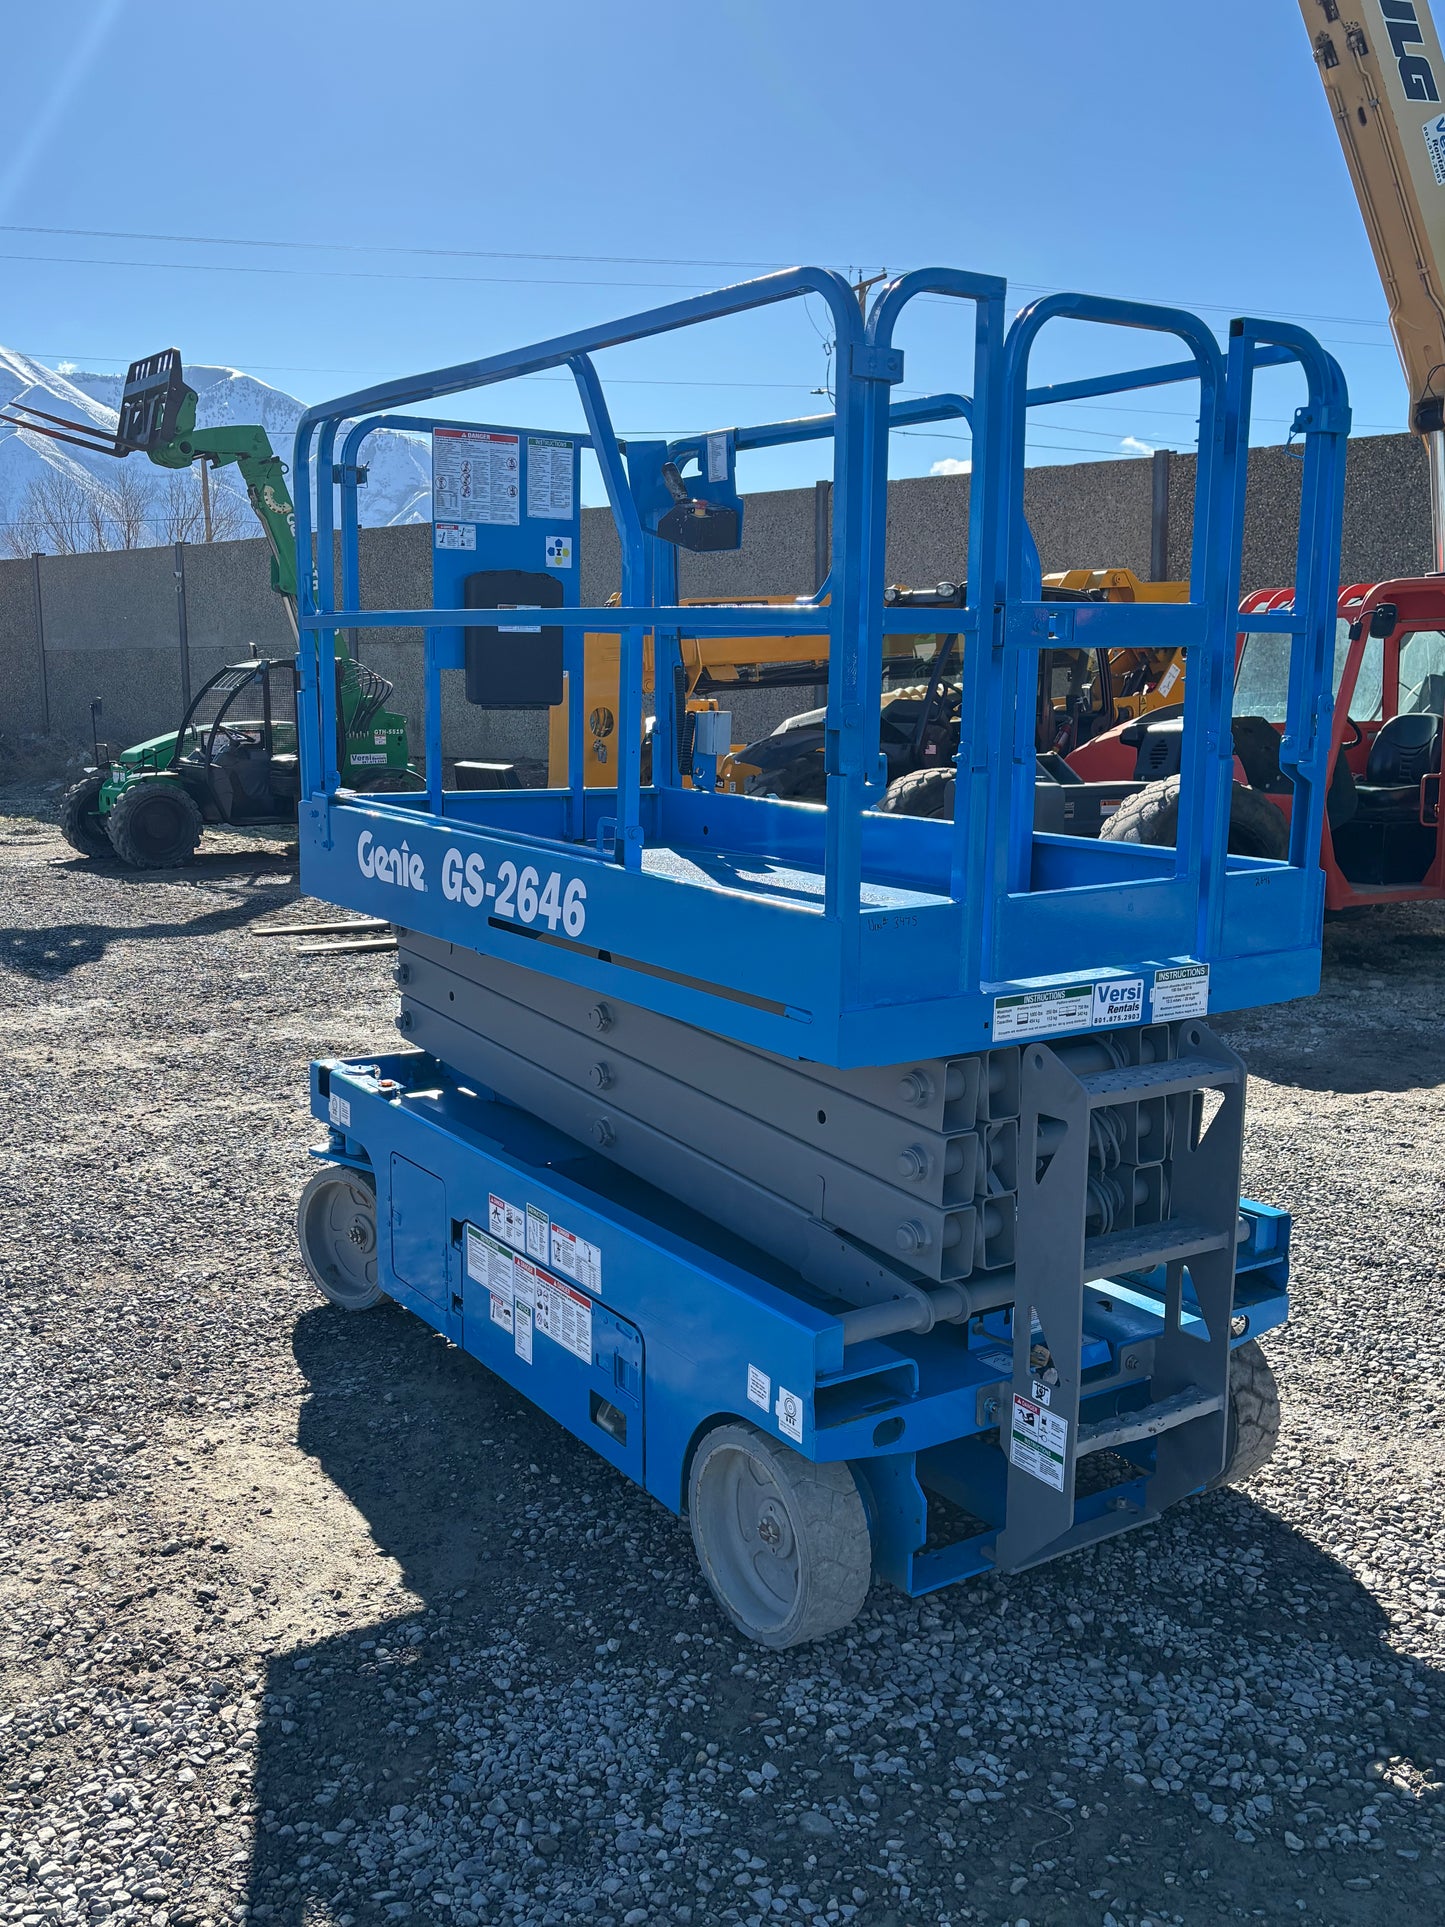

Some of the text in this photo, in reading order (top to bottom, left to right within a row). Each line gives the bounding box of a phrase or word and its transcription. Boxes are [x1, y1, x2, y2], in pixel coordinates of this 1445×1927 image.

[1378, 0, 1441, 103] JLG
[467, 433, 491, 441] DANGER
[535, 440, 567, 448] INSTRUCTIONS
[357, 830, 588, 938] Genie GS-2646
[1158, 967, 1206, 981] INSTRUCTIONS
[1023, 990, 1066, 1004] INSTRUCTIONS
[1098, 982, 1142, 1003] Versi
[1107, 1002, 1140, 1015] Rentals
[1093, 1013, 1140, 1024] 801.875.2903
[520, 1259, 534, 1274] DANGER
[556, 1281, 571, 1295] DANGER
[517, 1302, 530, 1314] NOTICE
[1021, 1400, 1038, 1413] DANGER
[1023, 1437, 1052, 1456] INSTRUCTIONS
